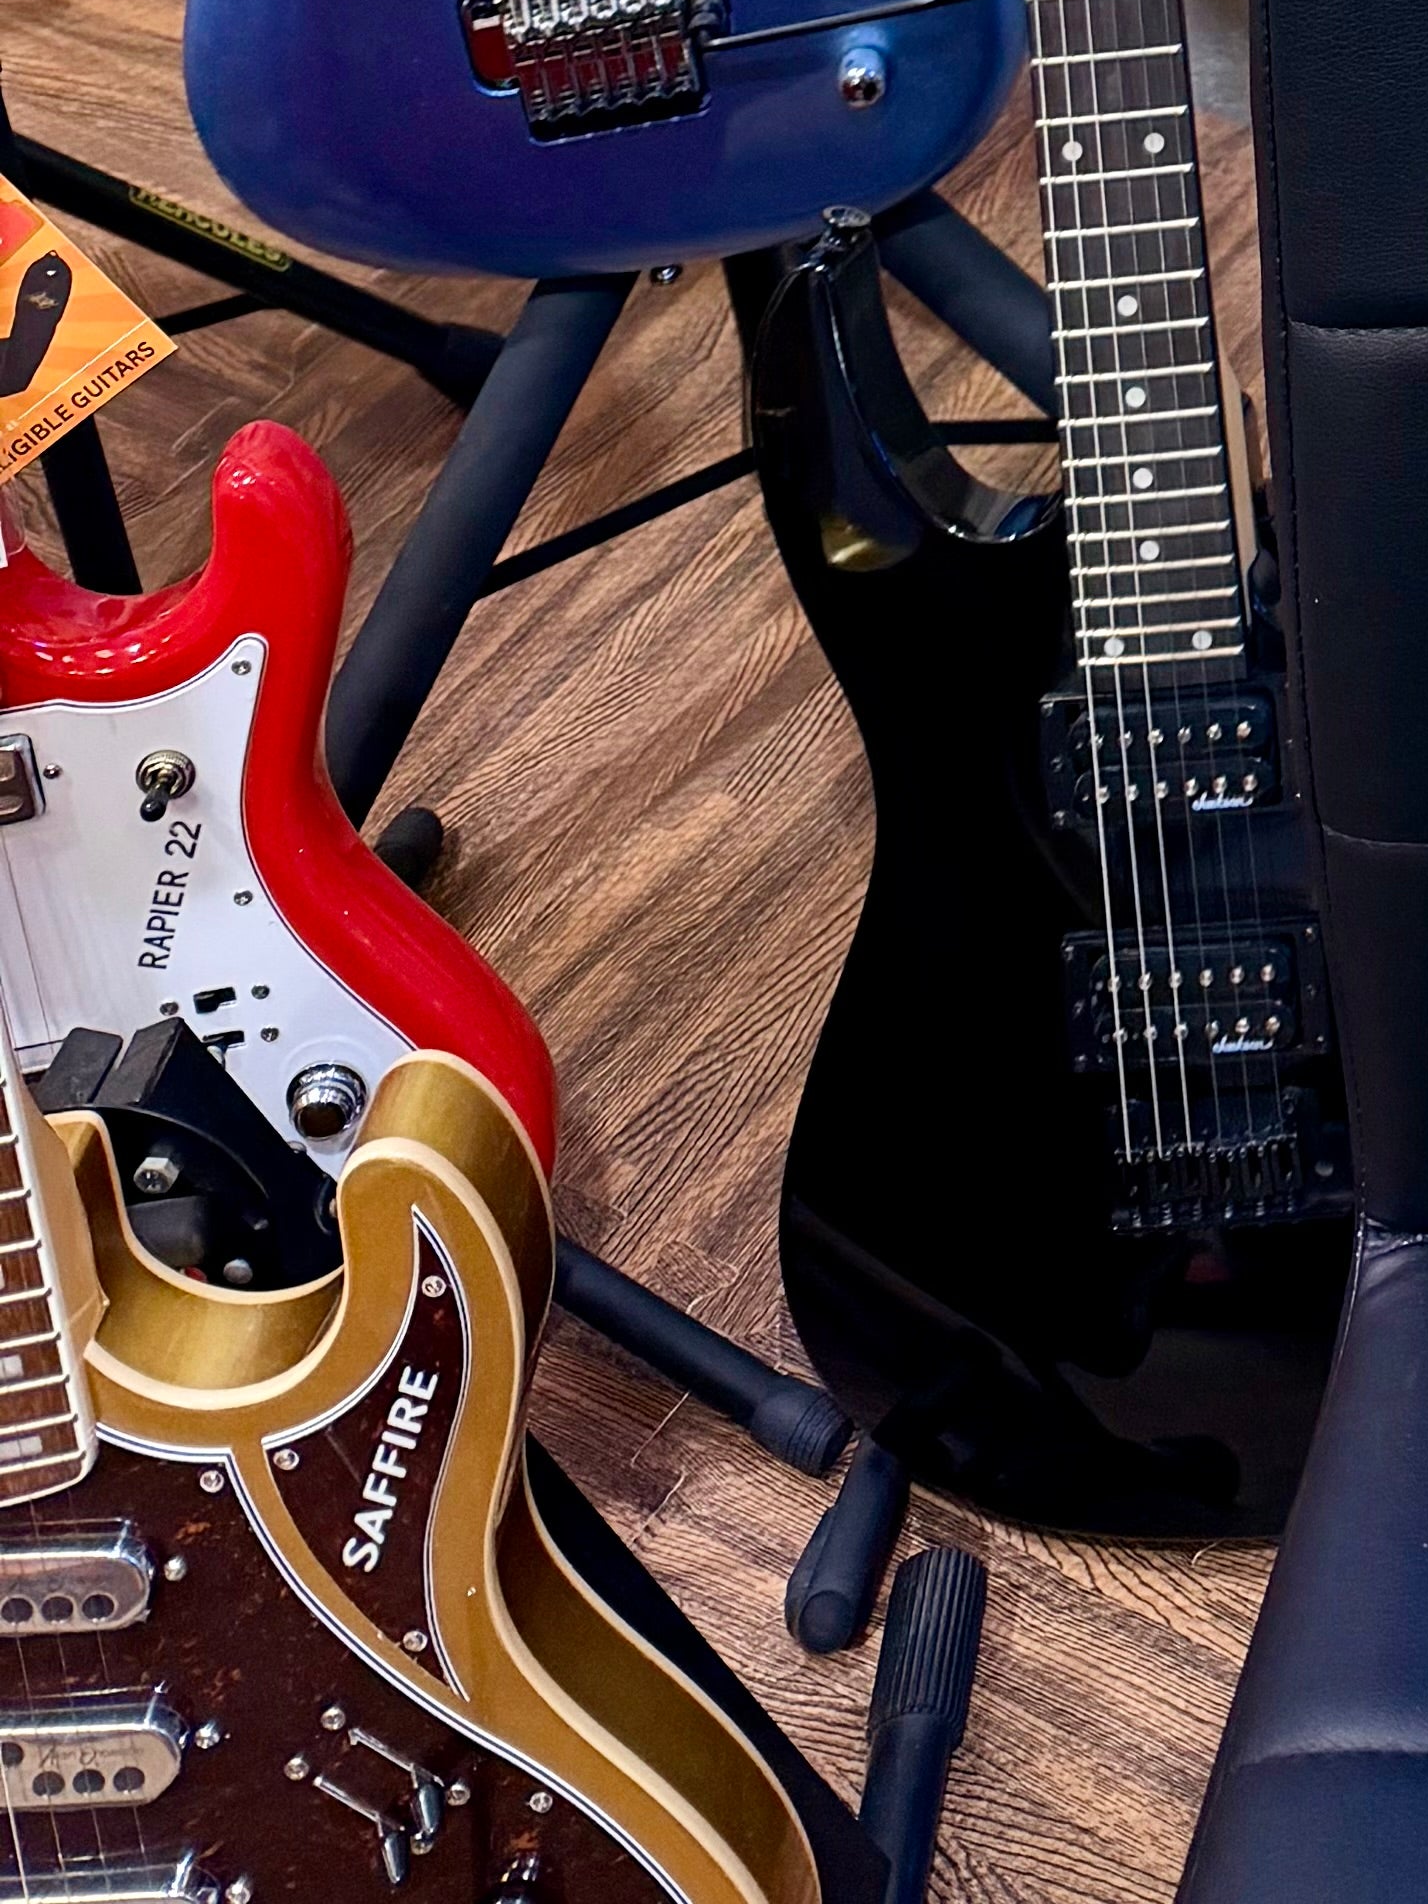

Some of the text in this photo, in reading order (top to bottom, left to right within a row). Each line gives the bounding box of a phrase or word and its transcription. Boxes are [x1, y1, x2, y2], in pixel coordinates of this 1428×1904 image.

[70, 341, 156, 409] GUITARS
[138, 822, 203, 971] RAPIER 22
[342, 1365, 440, 1574] SAFFIRE
